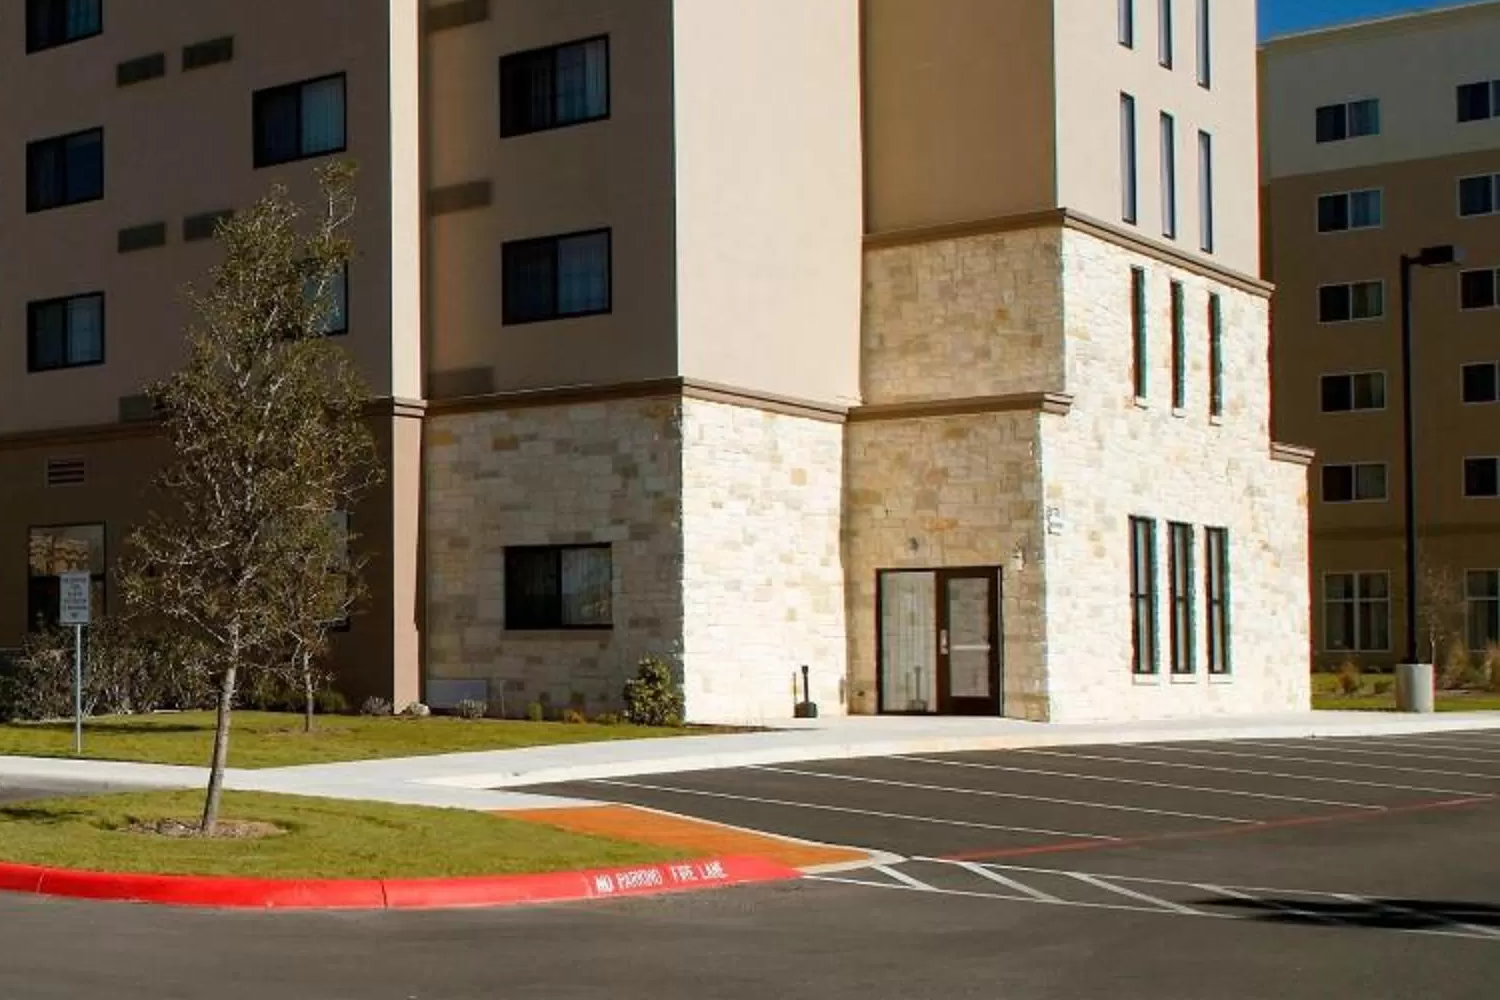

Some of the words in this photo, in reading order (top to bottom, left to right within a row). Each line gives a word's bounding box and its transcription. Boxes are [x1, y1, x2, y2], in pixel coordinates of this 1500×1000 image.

[595, 874, 613, 893] NO
[615, 868, 663, 889] PARKING
[670, 864, 699, 883] FIRE
[697, 860, 730, 880] LANE
